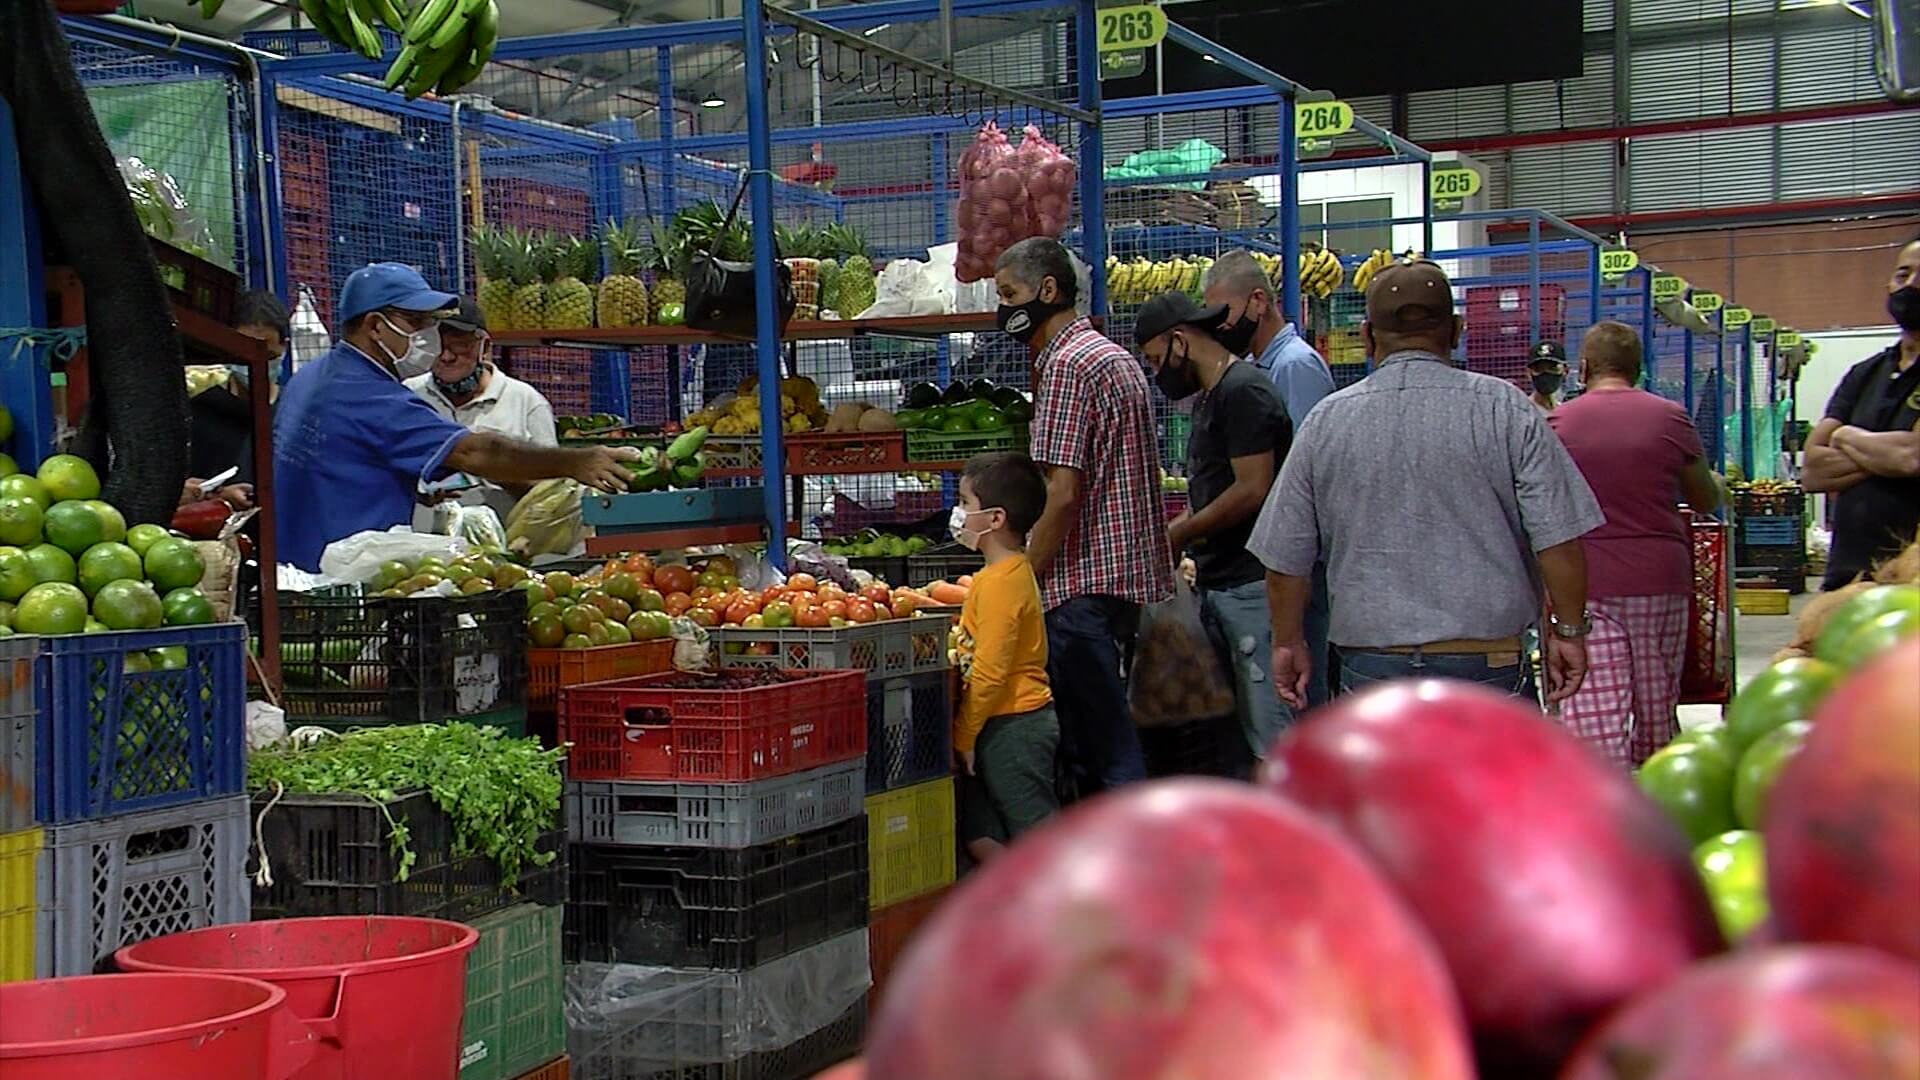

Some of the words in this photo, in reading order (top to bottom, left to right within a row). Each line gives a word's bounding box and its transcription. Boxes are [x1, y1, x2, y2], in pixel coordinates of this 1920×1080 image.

[1103, 10, 1153, 44] 263
[1301, 106, 1342, 131] 264
[1435, 173, 1470, 193] 265
[1604, 254, 1631, 268] 302
[1655, 279, 1679, 292] 303
[1695, 296, 1717, 308] 304
